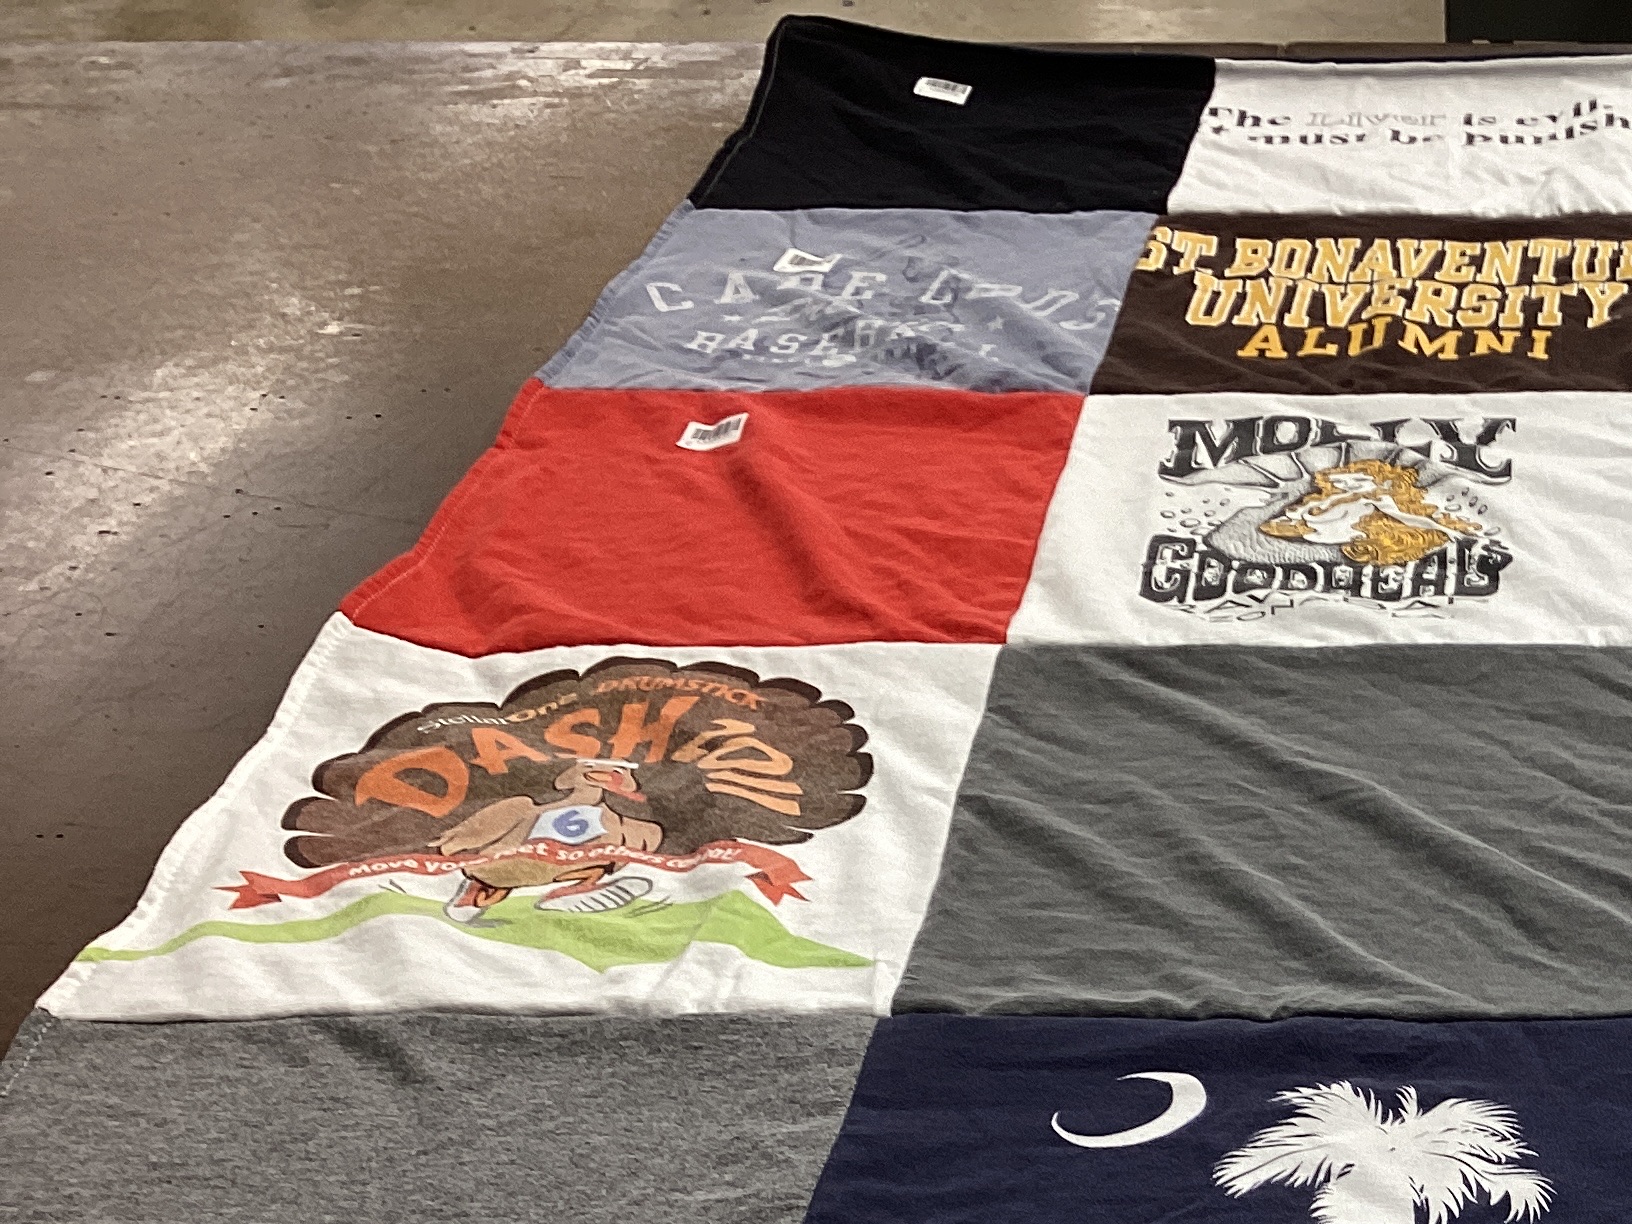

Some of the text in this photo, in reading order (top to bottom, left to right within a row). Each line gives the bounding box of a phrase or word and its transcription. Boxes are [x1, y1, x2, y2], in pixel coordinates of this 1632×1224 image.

[1185, 271, 1629, 329] UNIVERSITY
[1237, 316, 1553, 361] ALUMNI
[1158, 416, 1517, 479] MOLLY
[355, 695, 701, 818] DASH
[554, 807, 592, 838] 6
